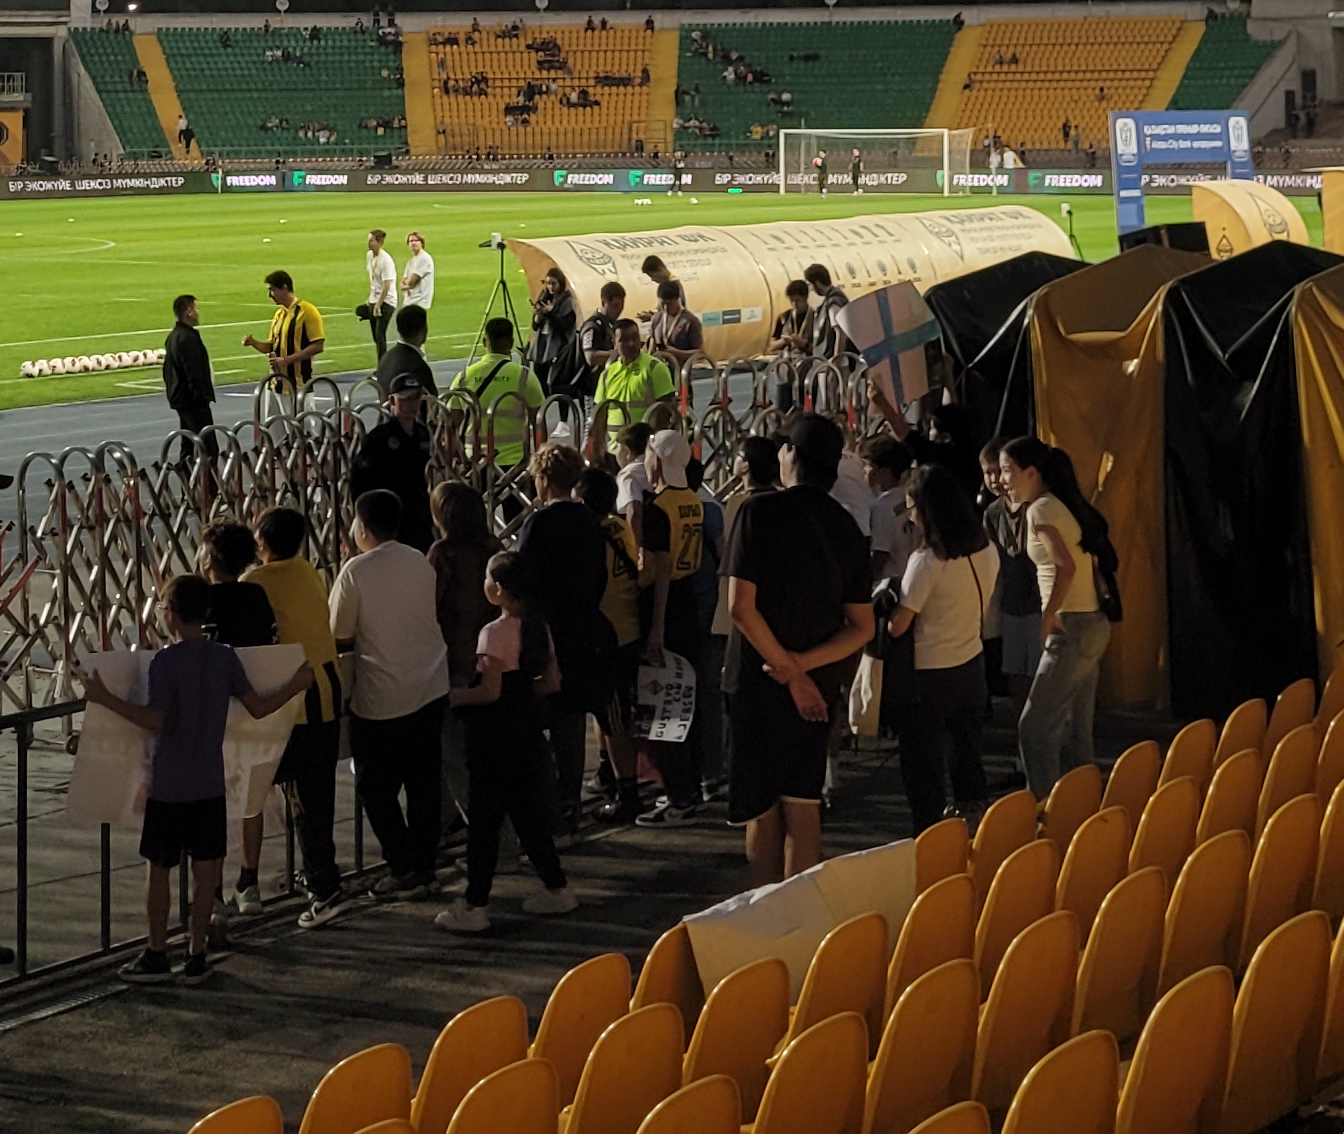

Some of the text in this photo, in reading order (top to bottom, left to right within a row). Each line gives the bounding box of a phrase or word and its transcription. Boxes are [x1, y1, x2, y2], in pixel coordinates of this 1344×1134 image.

[8, 181, 24, 192] БІР
[75, 178, 111, 191] ШЕКСІЗ
[113, 176, 185, 190] МҮМКІНДІКТЕР
[226, 174, 276, 186] FREEDOM
[306, 174, 348, 185] FREEDOM
[567, 174, 614, 185] FREEDOM
[643, 174, 692, 185] FREEDM
[953, 174, 1009, 187] FREEDOM
[1044, 174, 1103, 188] FREEDOM
